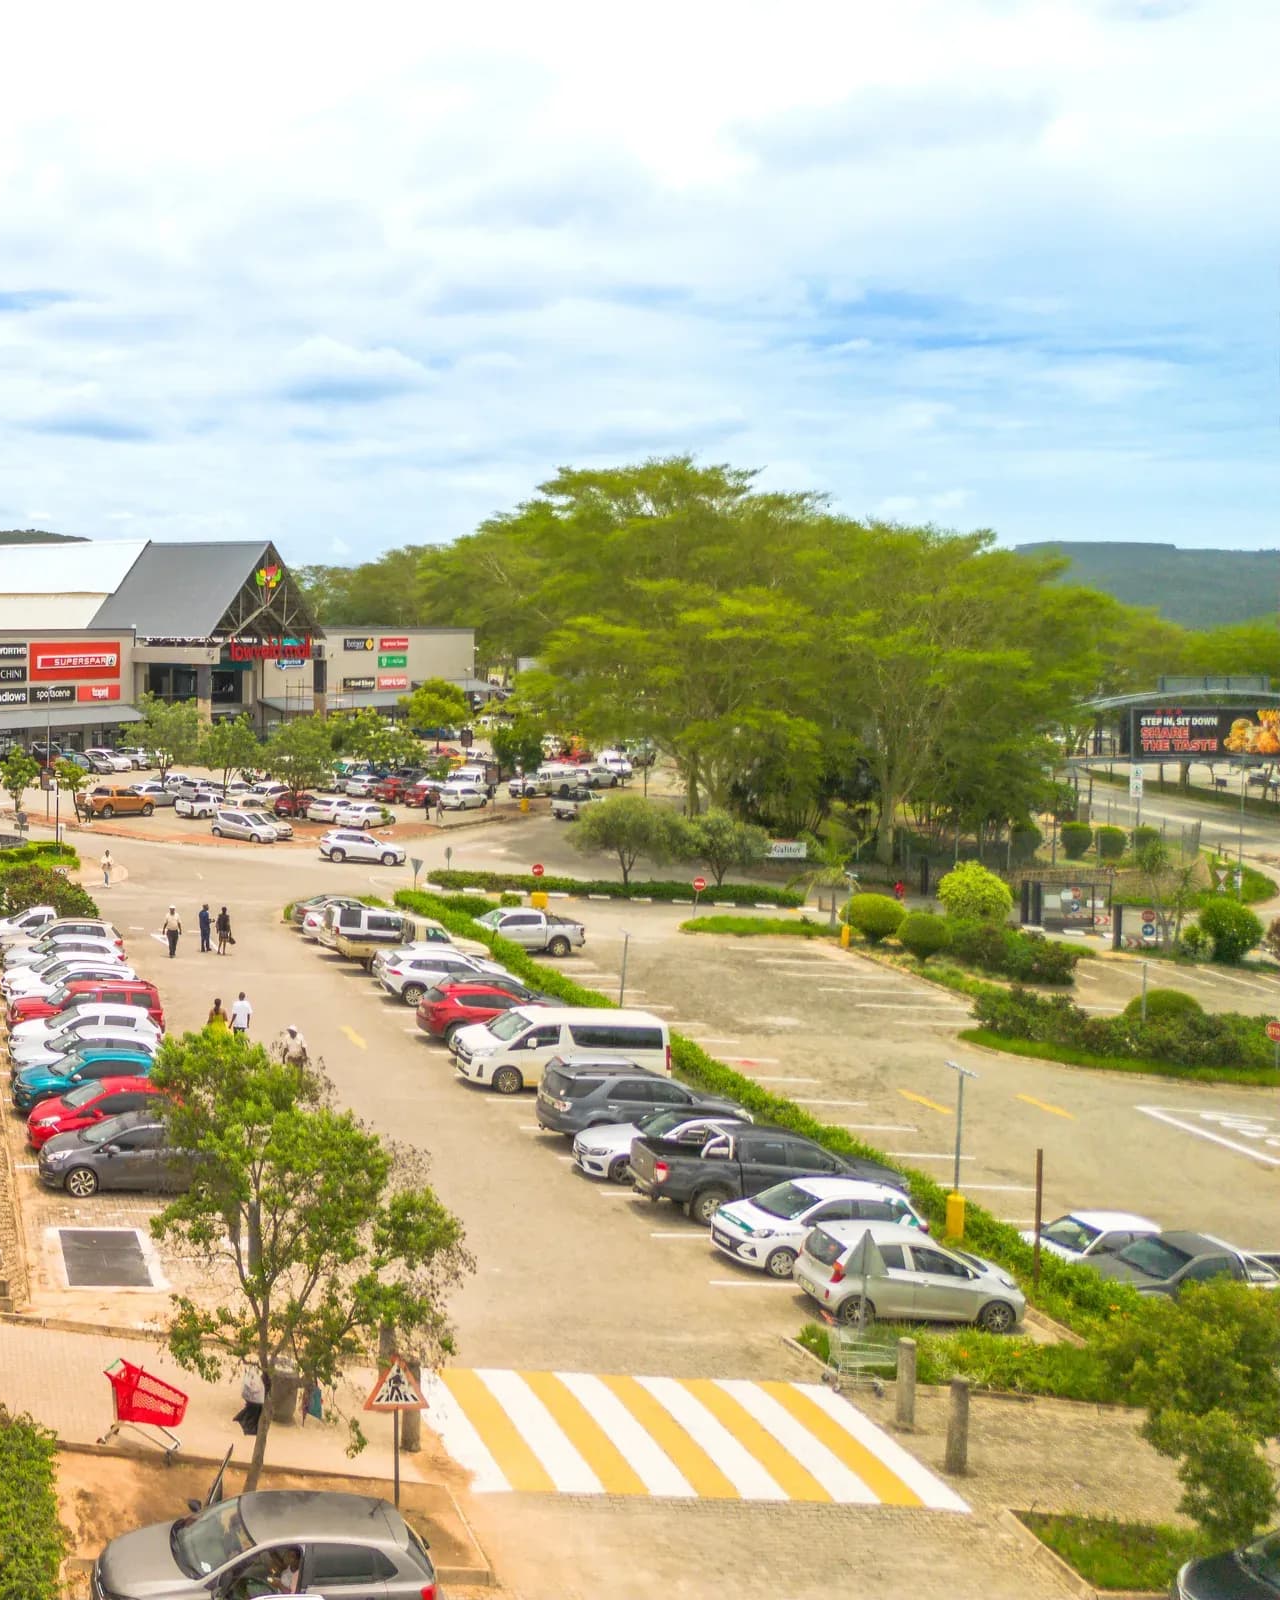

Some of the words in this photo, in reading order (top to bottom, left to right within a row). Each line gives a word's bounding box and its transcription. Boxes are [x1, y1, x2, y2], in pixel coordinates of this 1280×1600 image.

[54, 657, 107, 666] SUPERSPAR
[36, 689, 71, 700] spotscene
[1141, 717, 1162, 726] STEP
[1176, 717, 1191, 726] SIT
[1192, 717, 1218, 726] DOWN
[1140, 727, 1189, 739] SHARE
[1141, 739, 1170, 752] THE
[1173, 739, 1218, 751] TASTE
